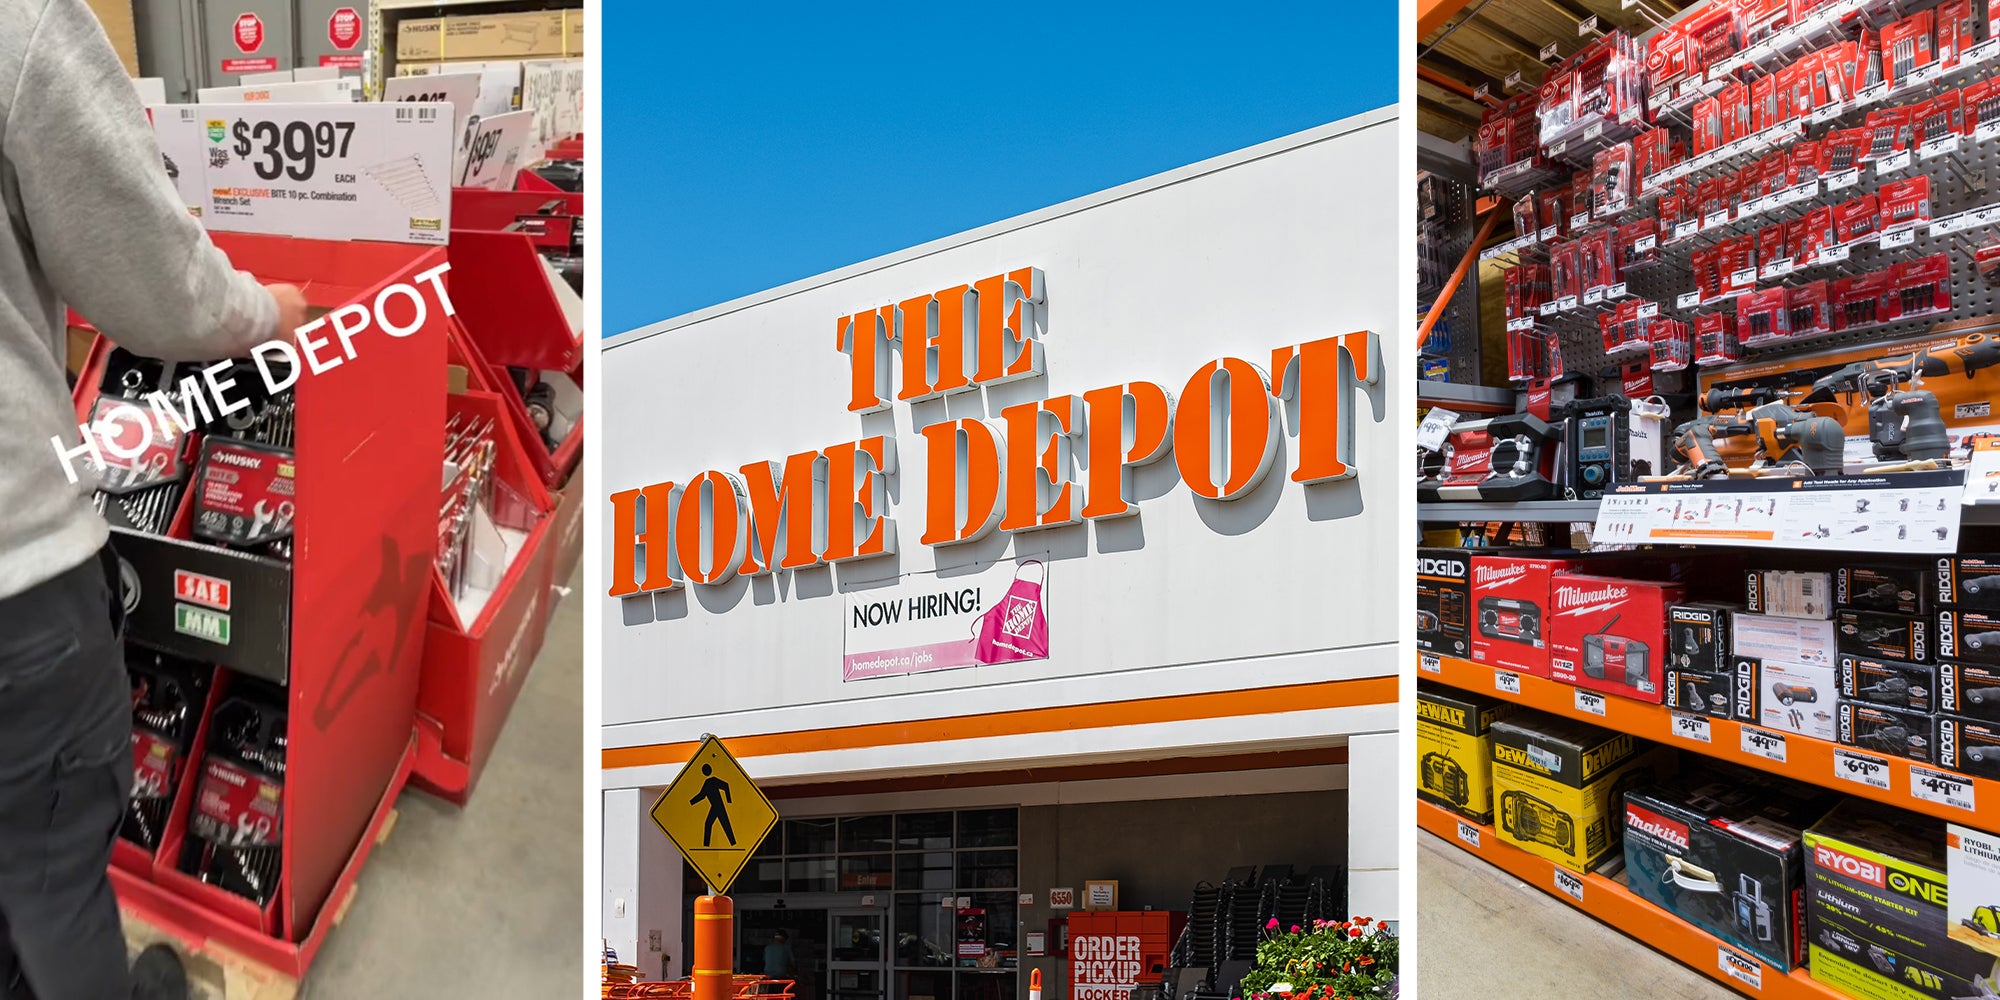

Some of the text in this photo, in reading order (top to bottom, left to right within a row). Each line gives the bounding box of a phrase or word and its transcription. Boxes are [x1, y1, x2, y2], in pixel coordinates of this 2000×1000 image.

[239, 18, 257, 27] STOP
[334, 13, 355, 22] STOP
[412, 24, 441, 33] HUSKY
[209, 147, 228, 158] Was
[335, 174, 356, 183] EACH
[213, 197, 251, 206] Wrench Set
[232, 188, 271, 198] EXCLUSIVE
[271, 190, 287, 199] BITE
[288, 190, 297, 200] 10
[311, 191, 357, 202] Combination
[837, 267, 1045, 413] THE
[224, 453, 262, 469] HUSKY
[609, 330, 1379, 597] HOME DEPOT
[1457, 451, 1490, 466] Milwaukee
[1616, 485, 1646, 493] JobMax
[1474, 563, 1526, 583] Milwaukee
[1938, 558, 1952, 603] RIDGID
[185, 577, 221, 604] SAE
[1748, 574, 1758, 611] RIDGID
[1838, 568, 1847, 605] RIDGID
[1554, 585, 1629, 609] Milwaukee
[853, 588, 981, 628] NOW HIRING!
[1005, 602, 1036, 633] HOME
[1011, 603, 1023, 616] THE
[1673, 611, 1711, 621] RIDGID
[186, 609, 220, 637] MM
[1014, 617, 1034, 635] DEPOT
[1914, 622, 1925, 660] RIDGID
[1940, 611, 1954, 657] RIDGID
[992, 638, 1034, 657] homedepot.ca
[852, 652, 933, 671] homedepot.ca/jobs
[1554, 660, 1573, 670] M12
[1843, 658, 1853, 696] RIDGID
[1668, 671, 1676, 707] RIDGID
[1738, 662, 1751, 718] RIDGID
[1941, 664, 1955, 711] RIDGID
[1840, 705, 1851, 742] RIDGID
[1748, 735, 1778, 750] $4997
[1941, 720, 1954, 767] RIDGID
[1843, 760, 1880, 776] $6900
[1921, 778, 1962, 796] $4997
[857, 874, 877, 886] Enter
[1818, 847, 1947, 906] RYOBI ONE
[1051, 891, 1073, 906] 6550
[1818, 890, 1861, 915] Lithium
[1828, 876, 1873, 900] LITHIUM-ION
[1874, 896, 1904, 912] STARTER
[1905, 907, 1919, 917] KIT
[1074, 936, 1141, 961] ORDER
[1819, 952, 1851, 970] Ensemble
[1074, 961, 1141, 984] PICKUP
[1077, 988, 1129, 1000] LOCKER
